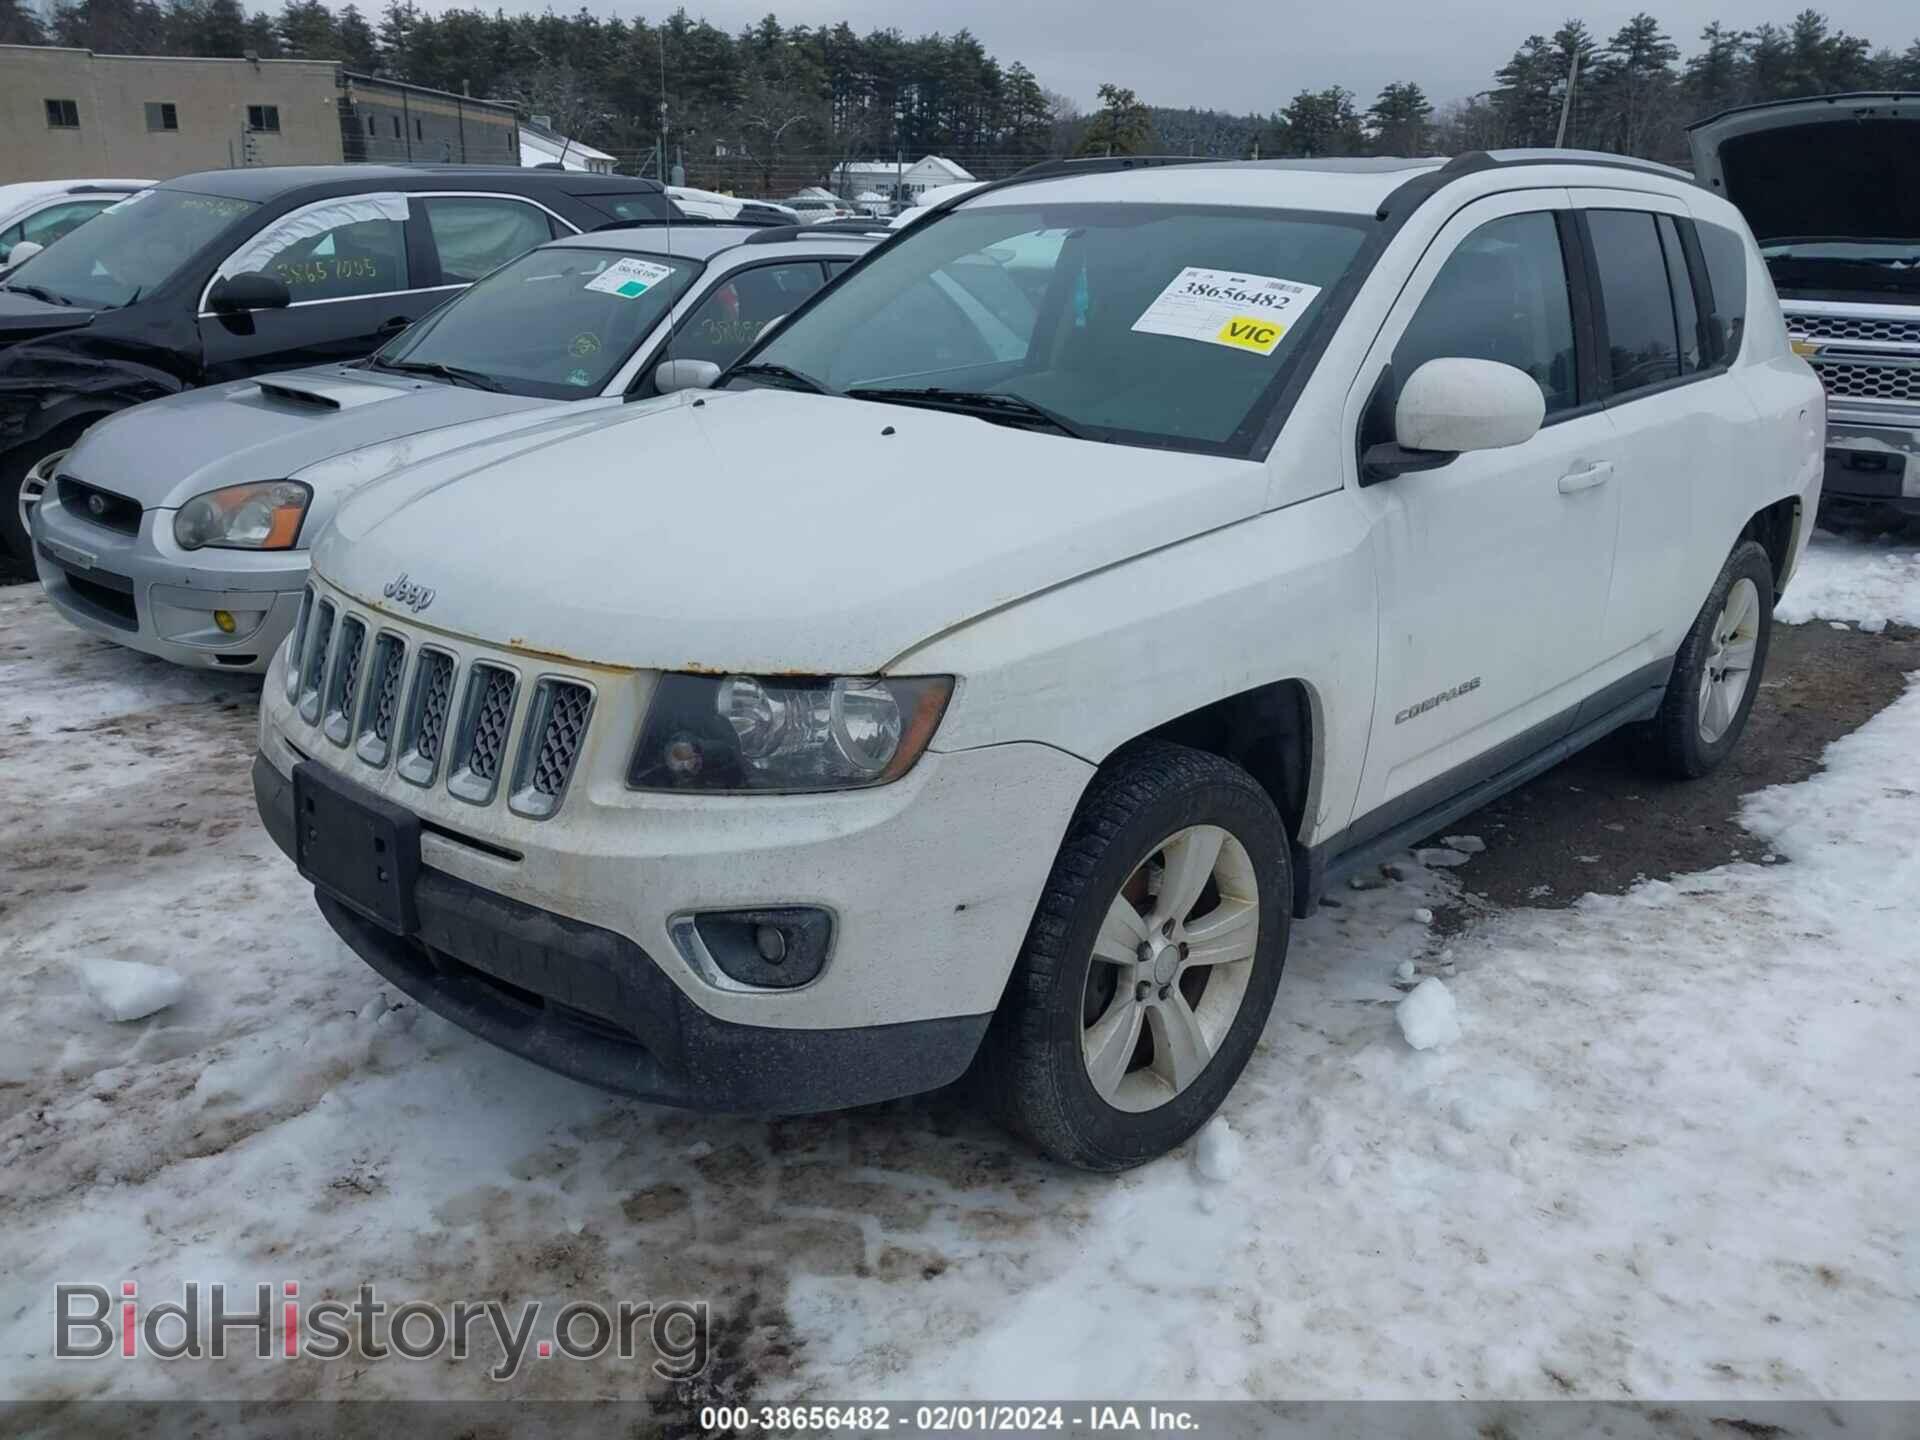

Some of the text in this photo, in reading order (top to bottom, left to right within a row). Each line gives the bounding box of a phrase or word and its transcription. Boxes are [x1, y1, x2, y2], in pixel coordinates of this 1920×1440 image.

[1178, 281, 1291, 310] 38656482
[1229, 322, 1275, 344] VIC
[383, 571, 436, 613] Jeep
[1394, 676, 1481, 725] COMPASS
